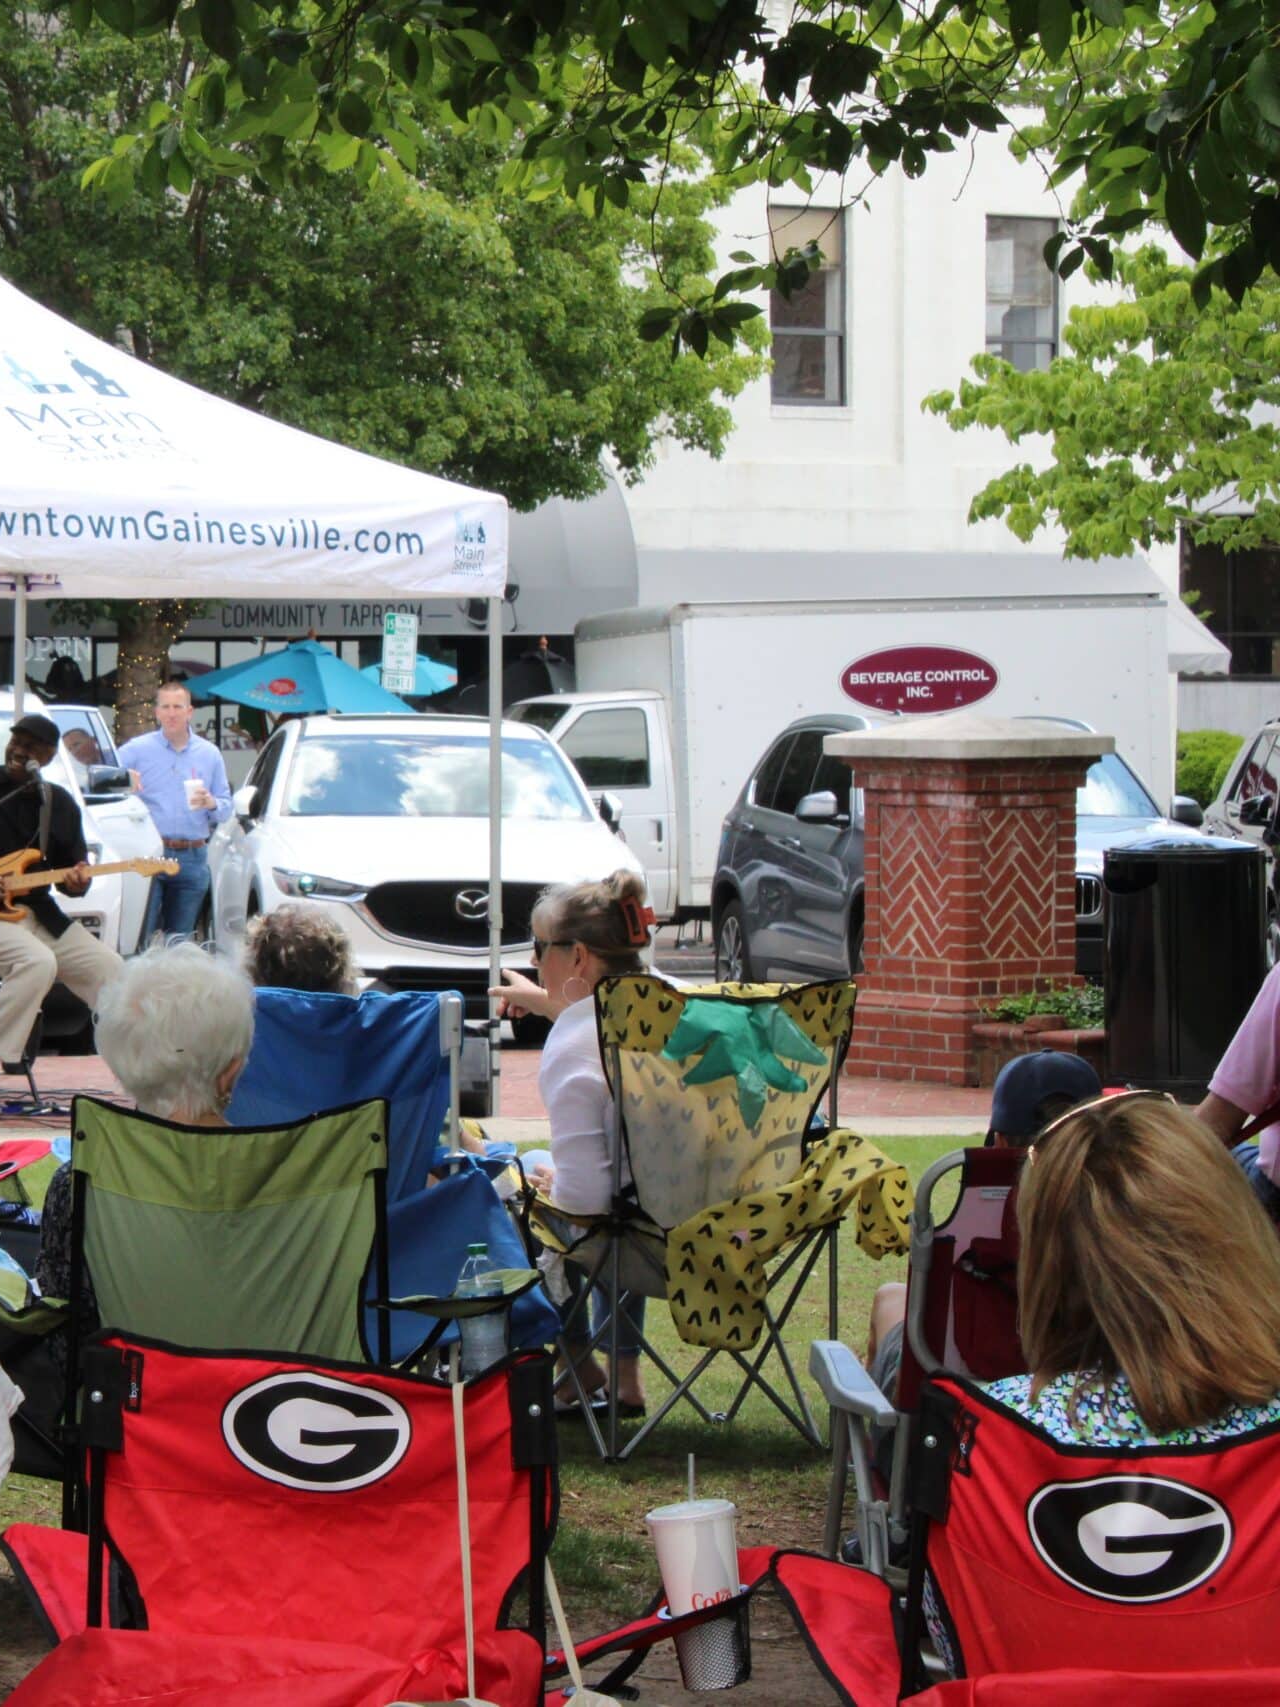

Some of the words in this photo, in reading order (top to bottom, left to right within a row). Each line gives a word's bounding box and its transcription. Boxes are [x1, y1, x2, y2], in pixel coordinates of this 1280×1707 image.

[4, 402, 163, 432] Main
[454, 544, 485, 560] Main
[453, 559, 483, 571] Street
[221, 604, 327, 628] COMMUNITY
[849, 671, 923, 685] BEVERAGE
[924, 669, 990, 682] CONTROL
[906, 686, 934, 698] INC.
[230, 1377, 405, 1487] G
[1034, 1479, 1228, 1600] G
